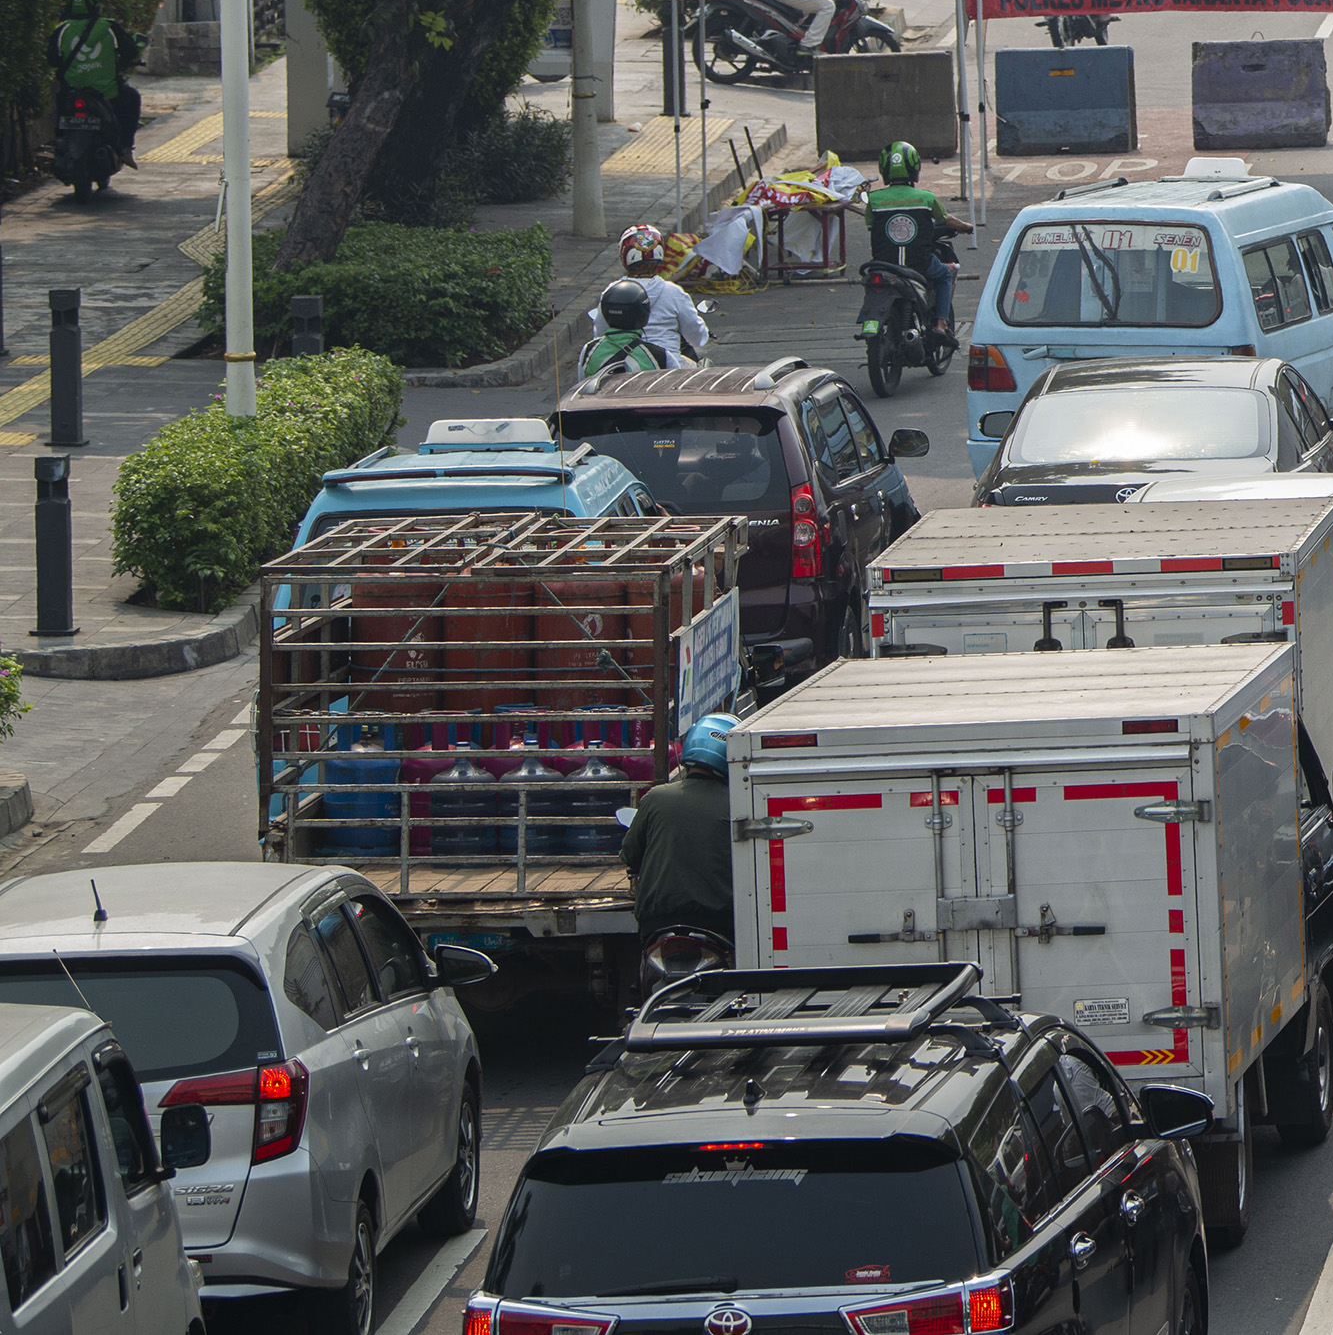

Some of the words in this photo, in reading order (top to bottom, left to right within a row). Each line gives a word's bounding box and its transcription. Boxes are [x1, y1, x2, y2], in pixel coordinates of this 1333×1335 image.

[933, 159, 1159, 184] STOP
[1101, 230, 1133, 251] 01
[1153, 233, 1202, 247] SENEN
[1170, 247, 1201, 273] 01
[748, 518, 780, 527] ENIA
[662, 1164, 809, 1187] sikumbang
[174, 1183, 236, 1195] SIGRA
